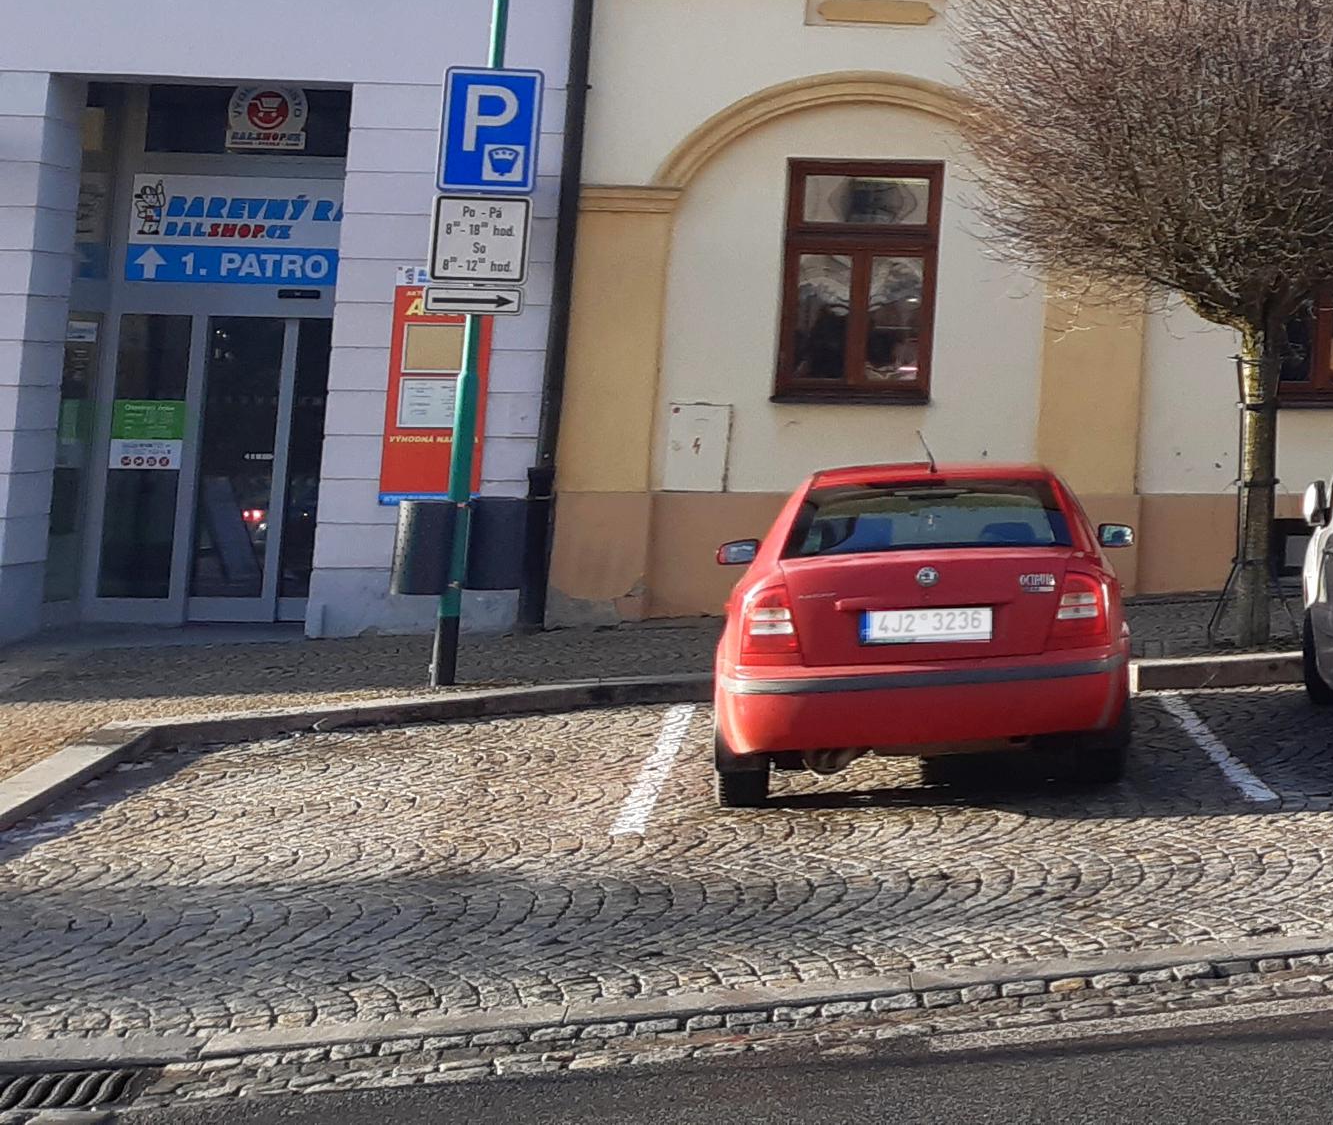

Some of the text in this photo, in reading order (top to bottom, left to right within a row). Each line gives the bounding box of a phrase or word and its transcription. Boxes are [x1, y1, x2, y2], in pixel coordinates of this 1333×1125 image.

[462, 84, 519, 151] P
[166, 195, 310, 221] BAREVNÝ
[462, 205, 476, 218] Po
[489, 206, 503, 218] Pá
[164, 222, 293, 240] BALSHOP.CZ
[493, 225, 515, 237] hod.
[472, 242, 486, 254] So
[182, 252, 329, 279] 1. PATRO
[490, 261, 512, 272] hod.
[878, 610, 983, 634] 4J2 3236
